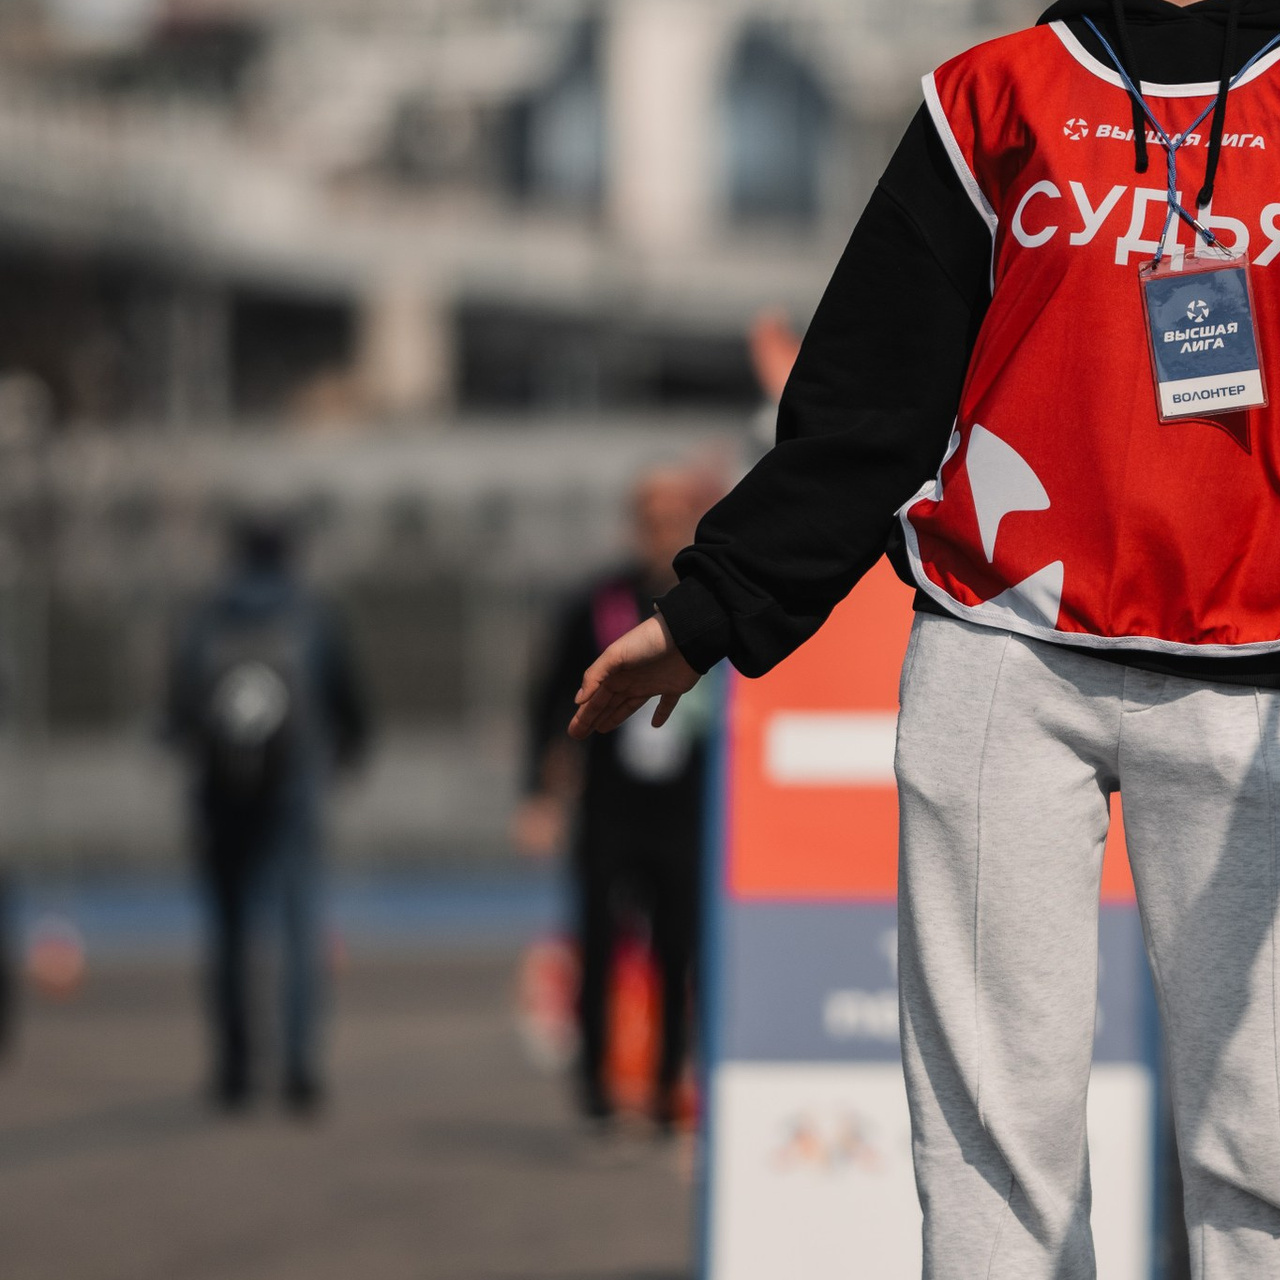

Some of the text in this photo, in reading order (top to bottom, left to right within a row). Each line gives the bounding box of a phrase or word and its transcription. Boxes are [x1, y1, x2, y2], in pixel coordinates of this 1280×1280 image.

[1095, 124, 1266, 150] ВЫШАЯ ИГА
[1163, 322, 1238, 343] ВЫСШАЯ
[1180, 337, 1225, 354] ЛИГА
[1172, 384, 1246, 404] ВОЛОНТЕР
